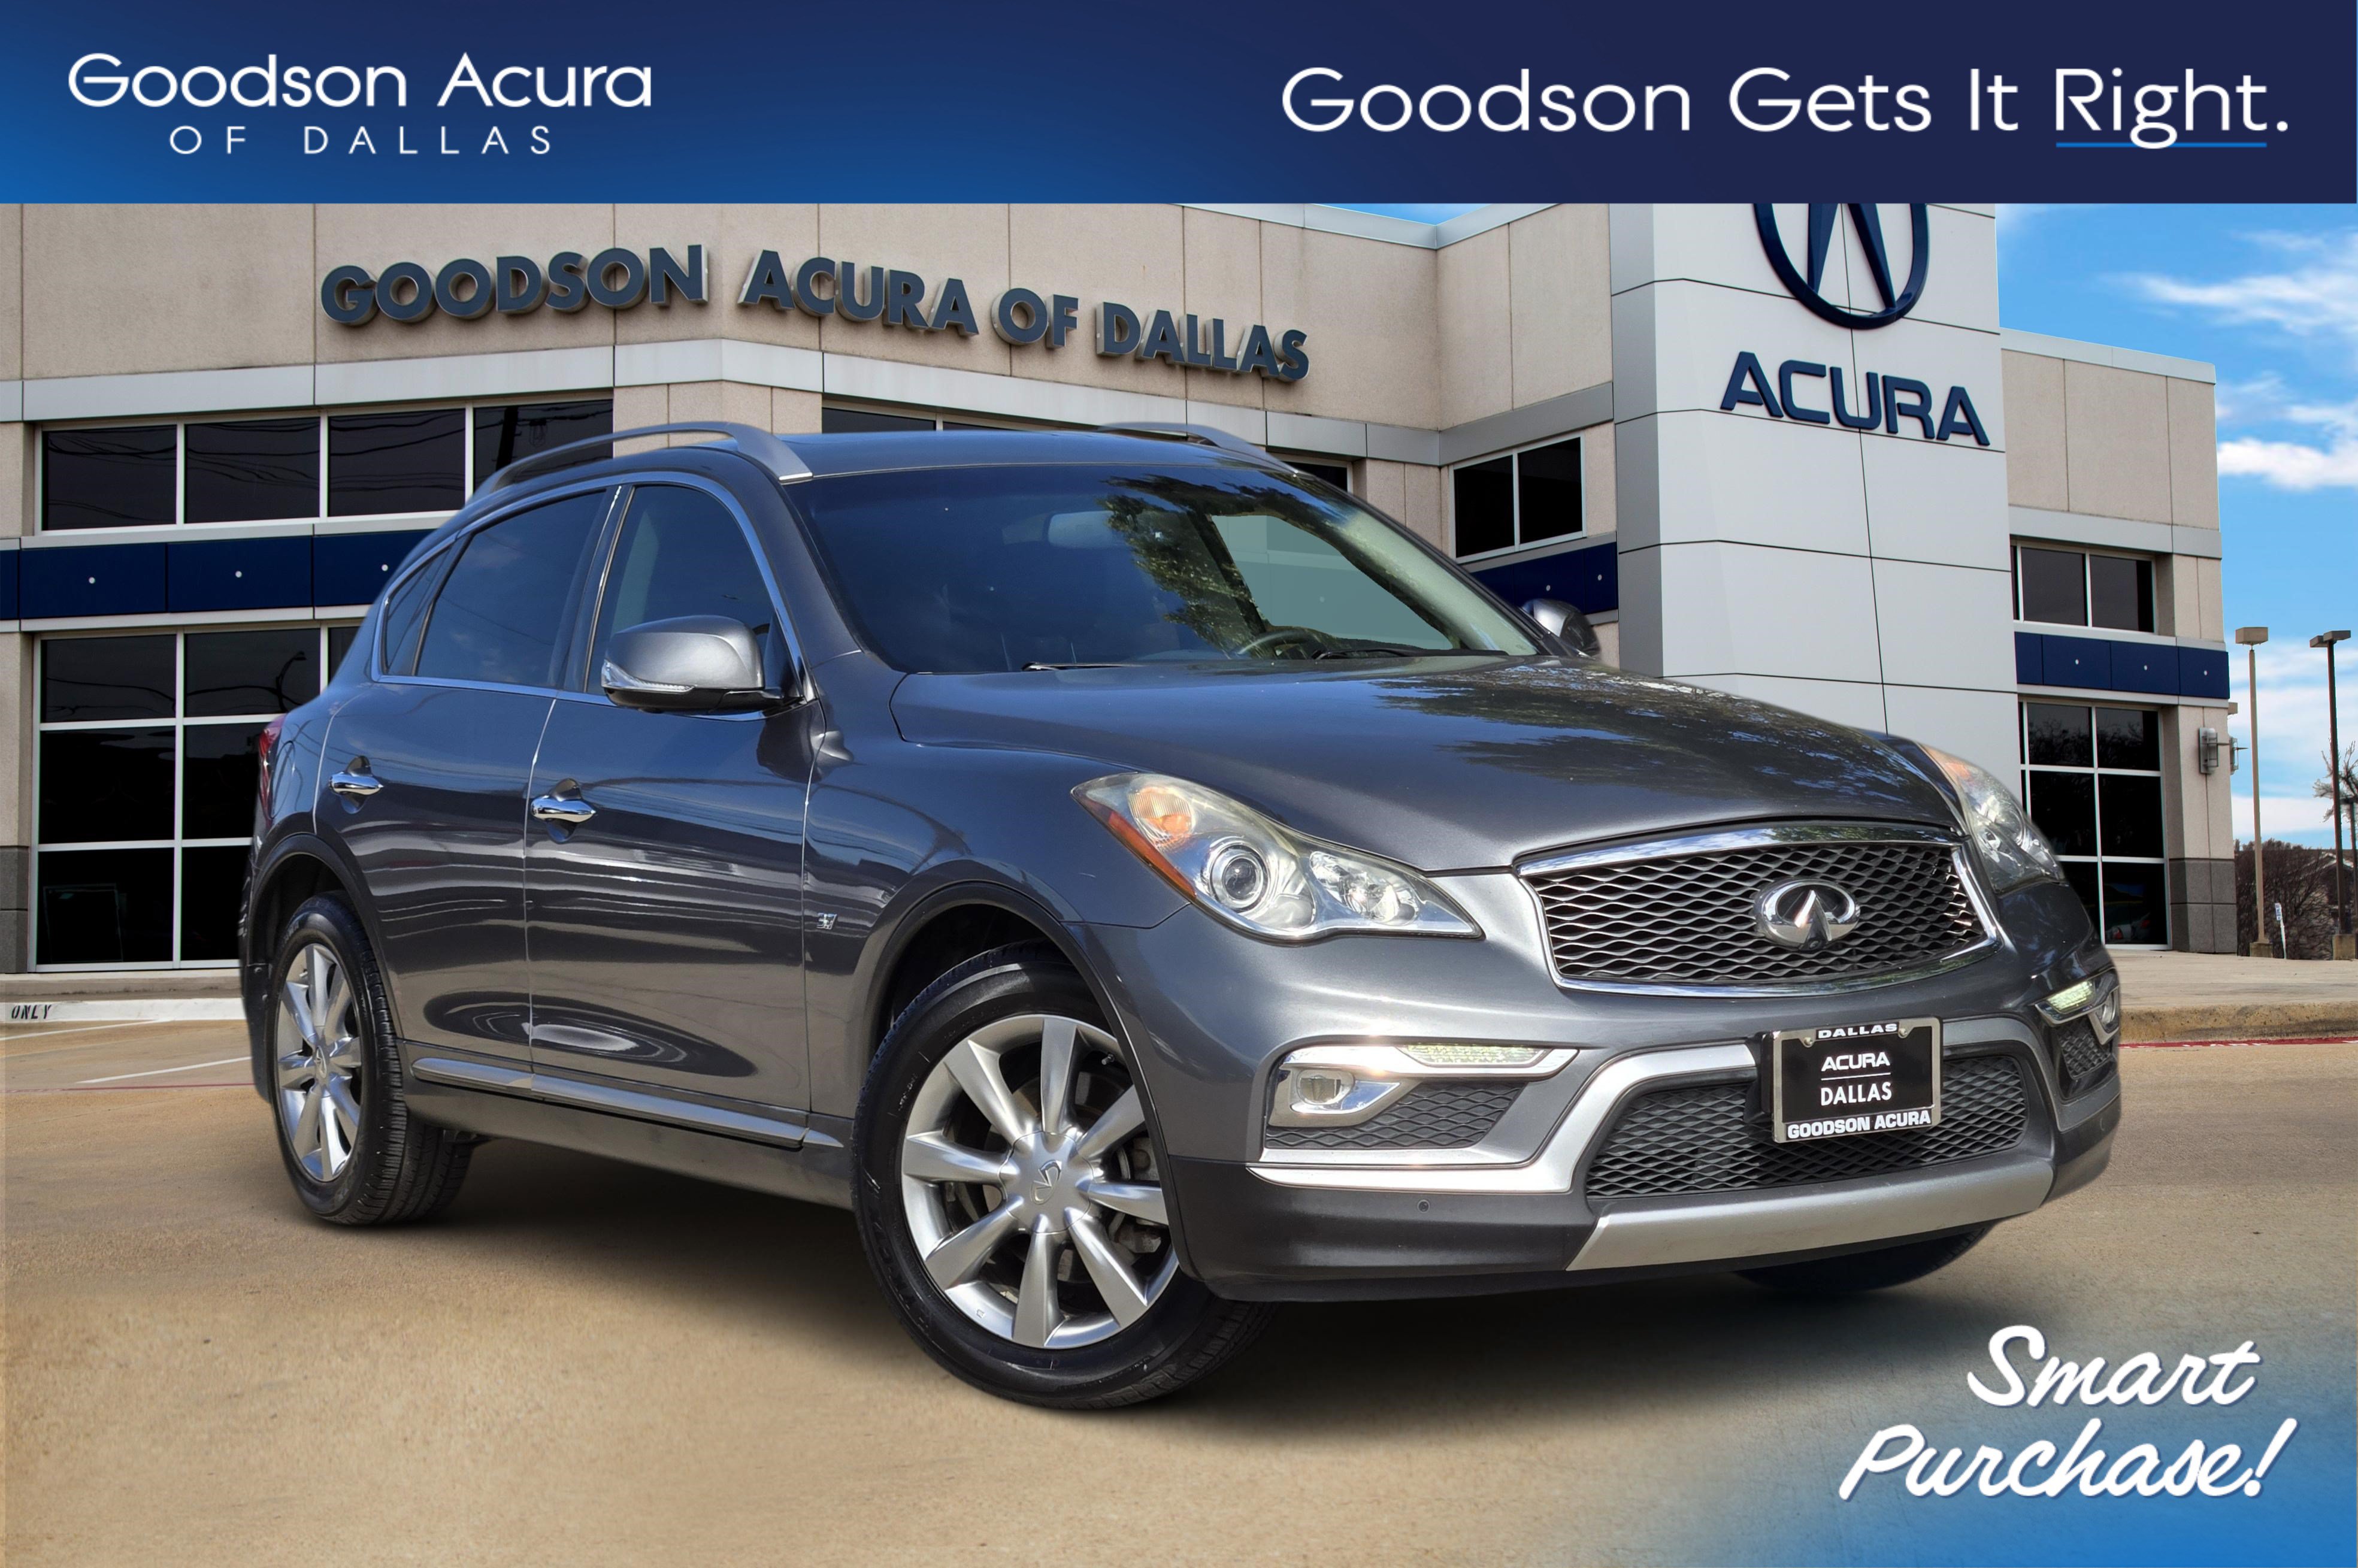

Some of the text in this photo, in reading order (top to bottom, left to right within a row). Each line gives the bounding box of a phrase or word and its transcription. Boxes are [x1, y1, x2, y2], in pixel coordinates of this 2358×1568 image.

[320, 244, 1310, 382] GOODSON ACURA OF DALLAS
[1720, 351, 1990, 446] ACURA
[11, 1004, 52, 1019] ONLY
[1818, 1023, 1898, 1039] DALLAS
[1821, 1052, 1891, 1071] ACURA
[1820, 1081, 1892, 1106] DALLAS
[1787, 1110, 1931, 1139] GOODSON ACURA
